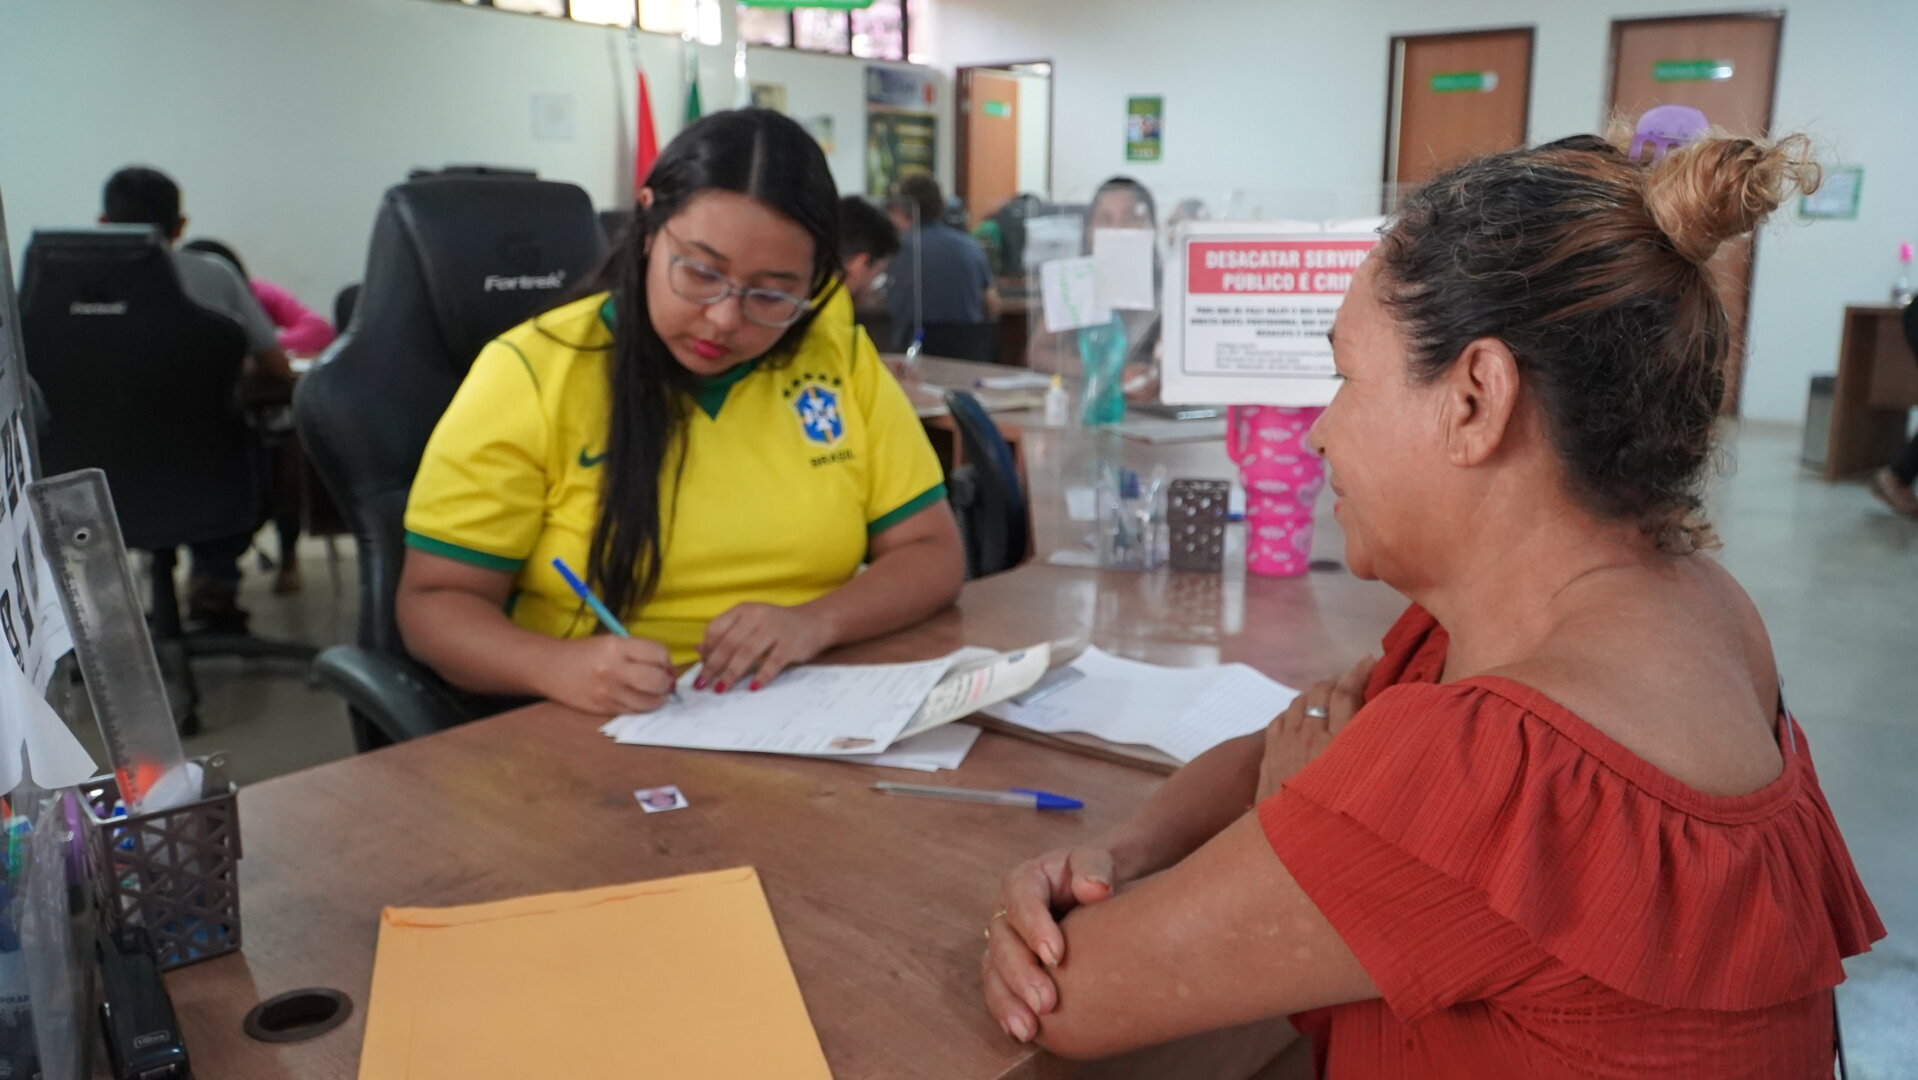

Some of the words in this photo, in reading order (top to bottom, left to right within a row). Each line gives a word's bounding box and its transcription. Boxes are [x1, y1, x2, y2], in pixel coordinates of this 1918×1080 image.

[1205, 249, 1300, 269] DESACATAR
[1304, 249, 1368, 268] SERVID
[1222, 268, 1296, 292] PÚBLICO
[1299, 268, 1310, 292] É
